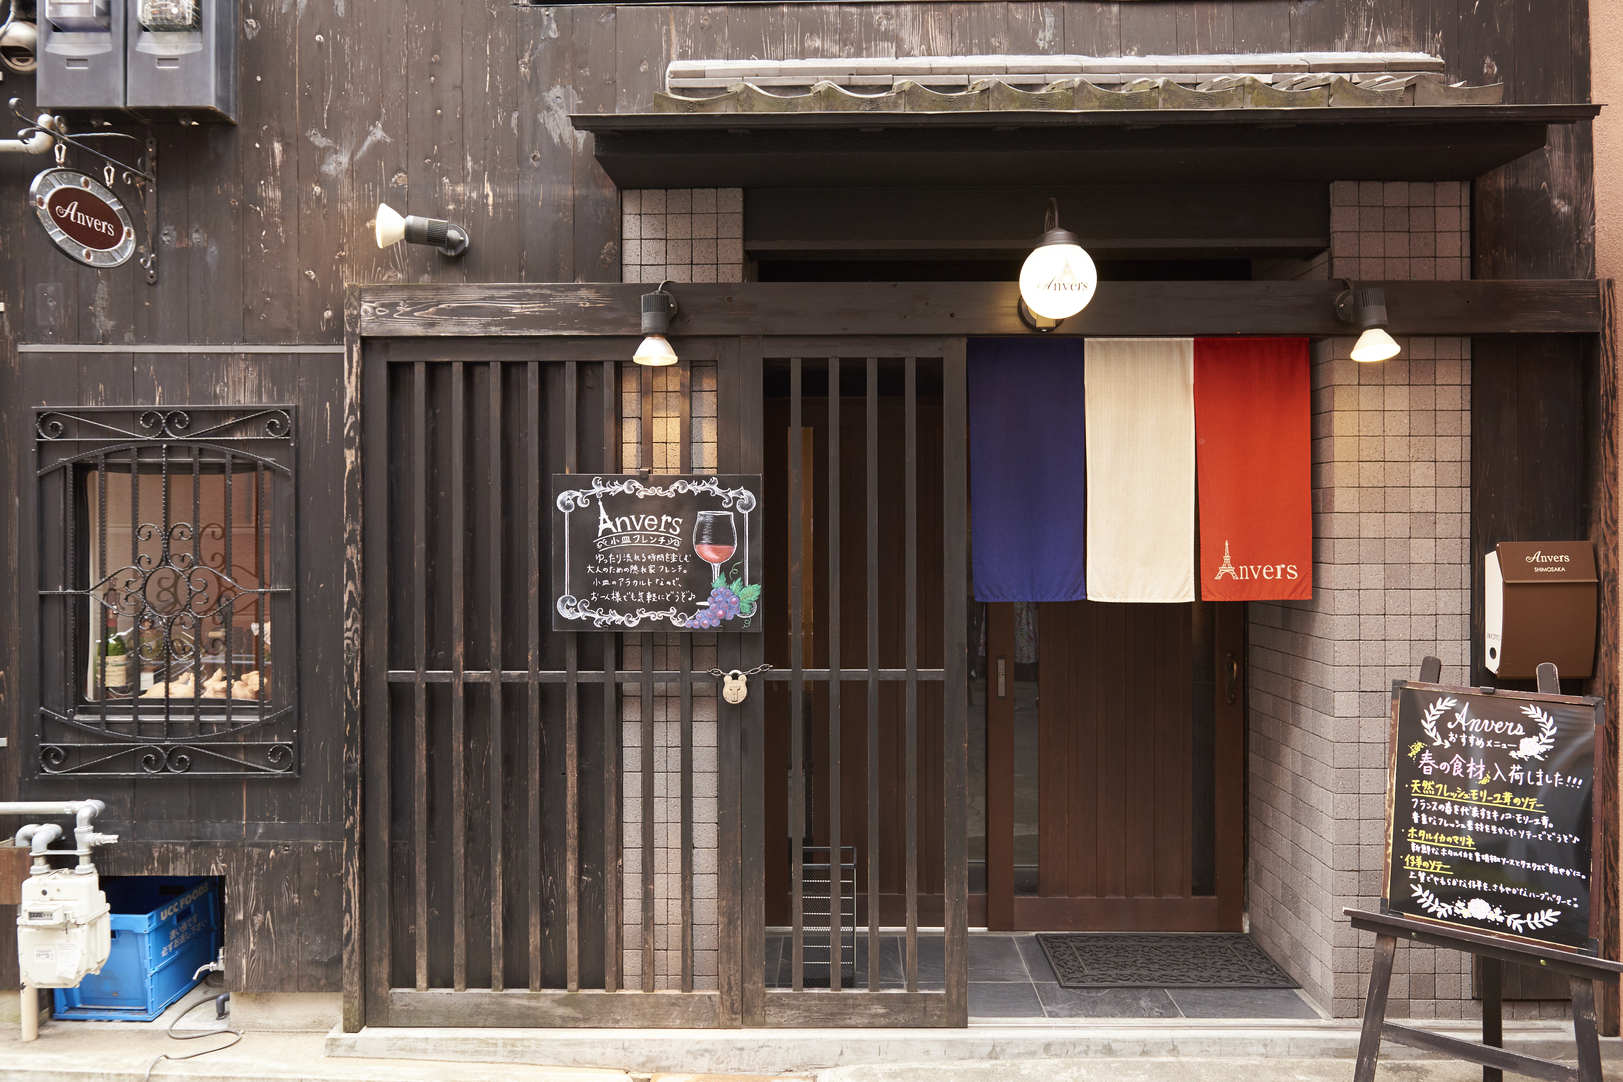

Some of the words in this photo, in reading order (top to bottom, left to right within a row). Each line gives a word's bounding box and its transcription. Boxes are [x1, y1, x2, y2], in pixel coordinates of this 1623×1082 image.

[55, 201, 115, 237] Anvers
[598, 499, 684, 538] Anvers
[610, 534, 666, 545] 小皿フレンチ
[1525, 550, 1571, 563] Anvers
[1214, 539, 1299, 580] Anvers
[1447, 701, 1526, 736] Anvers
[1448, 732, 1517, 749] おすすめメニュー
